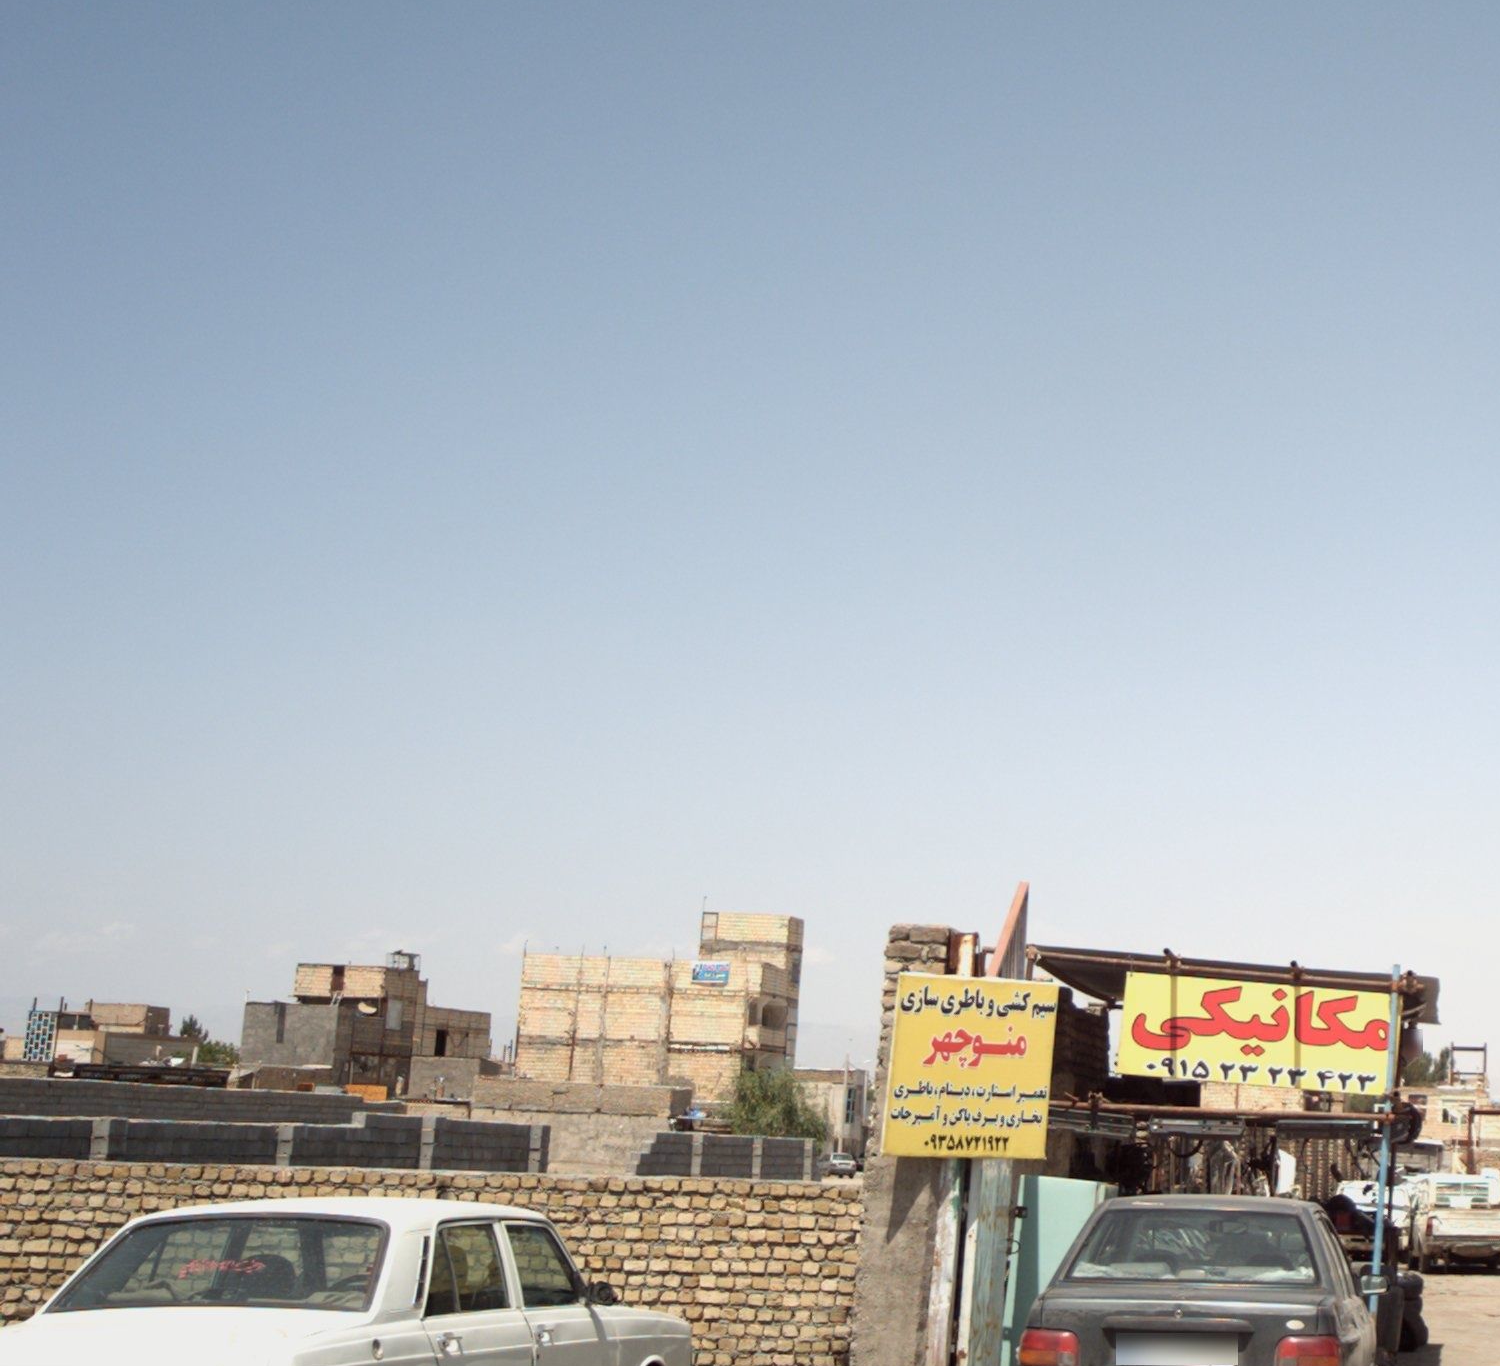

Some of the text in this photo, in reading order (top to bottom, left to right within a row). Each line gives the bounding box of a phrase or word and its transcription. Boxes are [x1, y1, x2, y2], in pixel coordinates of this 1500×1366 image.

[900, 985, 1056, 1019] سیم کشی و باطری سازی
[1131, 986, 1390, 1057] مکانیکی
[923, 1026, 1027, 1068] منوچهر
